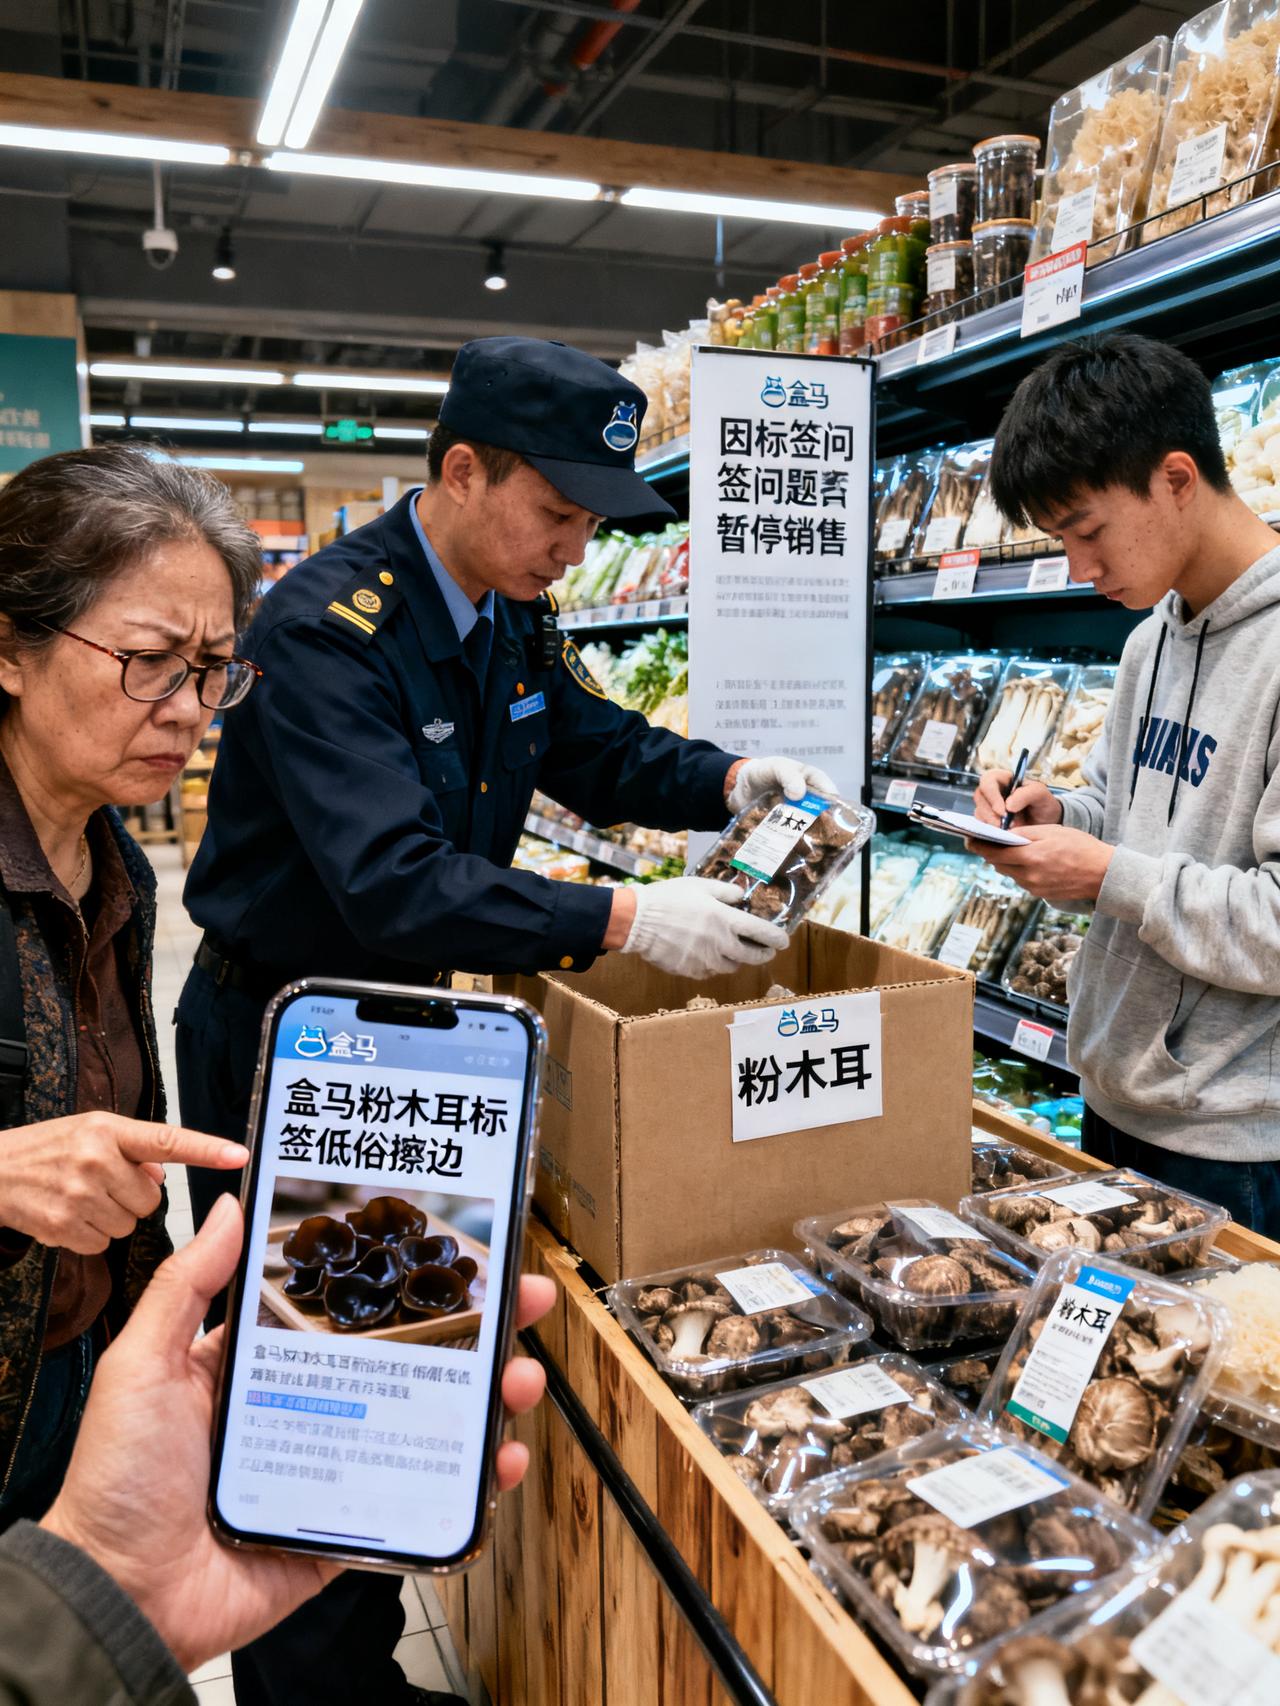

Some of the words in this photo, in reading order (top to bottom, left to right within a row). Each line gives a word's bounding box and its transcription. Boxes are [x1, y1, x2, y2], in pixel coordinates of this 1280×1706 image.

[787, 380, 829, 409] 盒马
[720, 417, 854, 462] 因标签问
[716, 512, 847, 557] 暂停销售
[800, 1008, 839, 1034] 盒马
[328, 1031, 378, 1062] 盒马
[738, 1043, 872, 1107] 粉木耳
[283, 1077, 508, 1138] 盒马粉木耳标
[278, 1123, 463, 1178] 签低俗擦边
